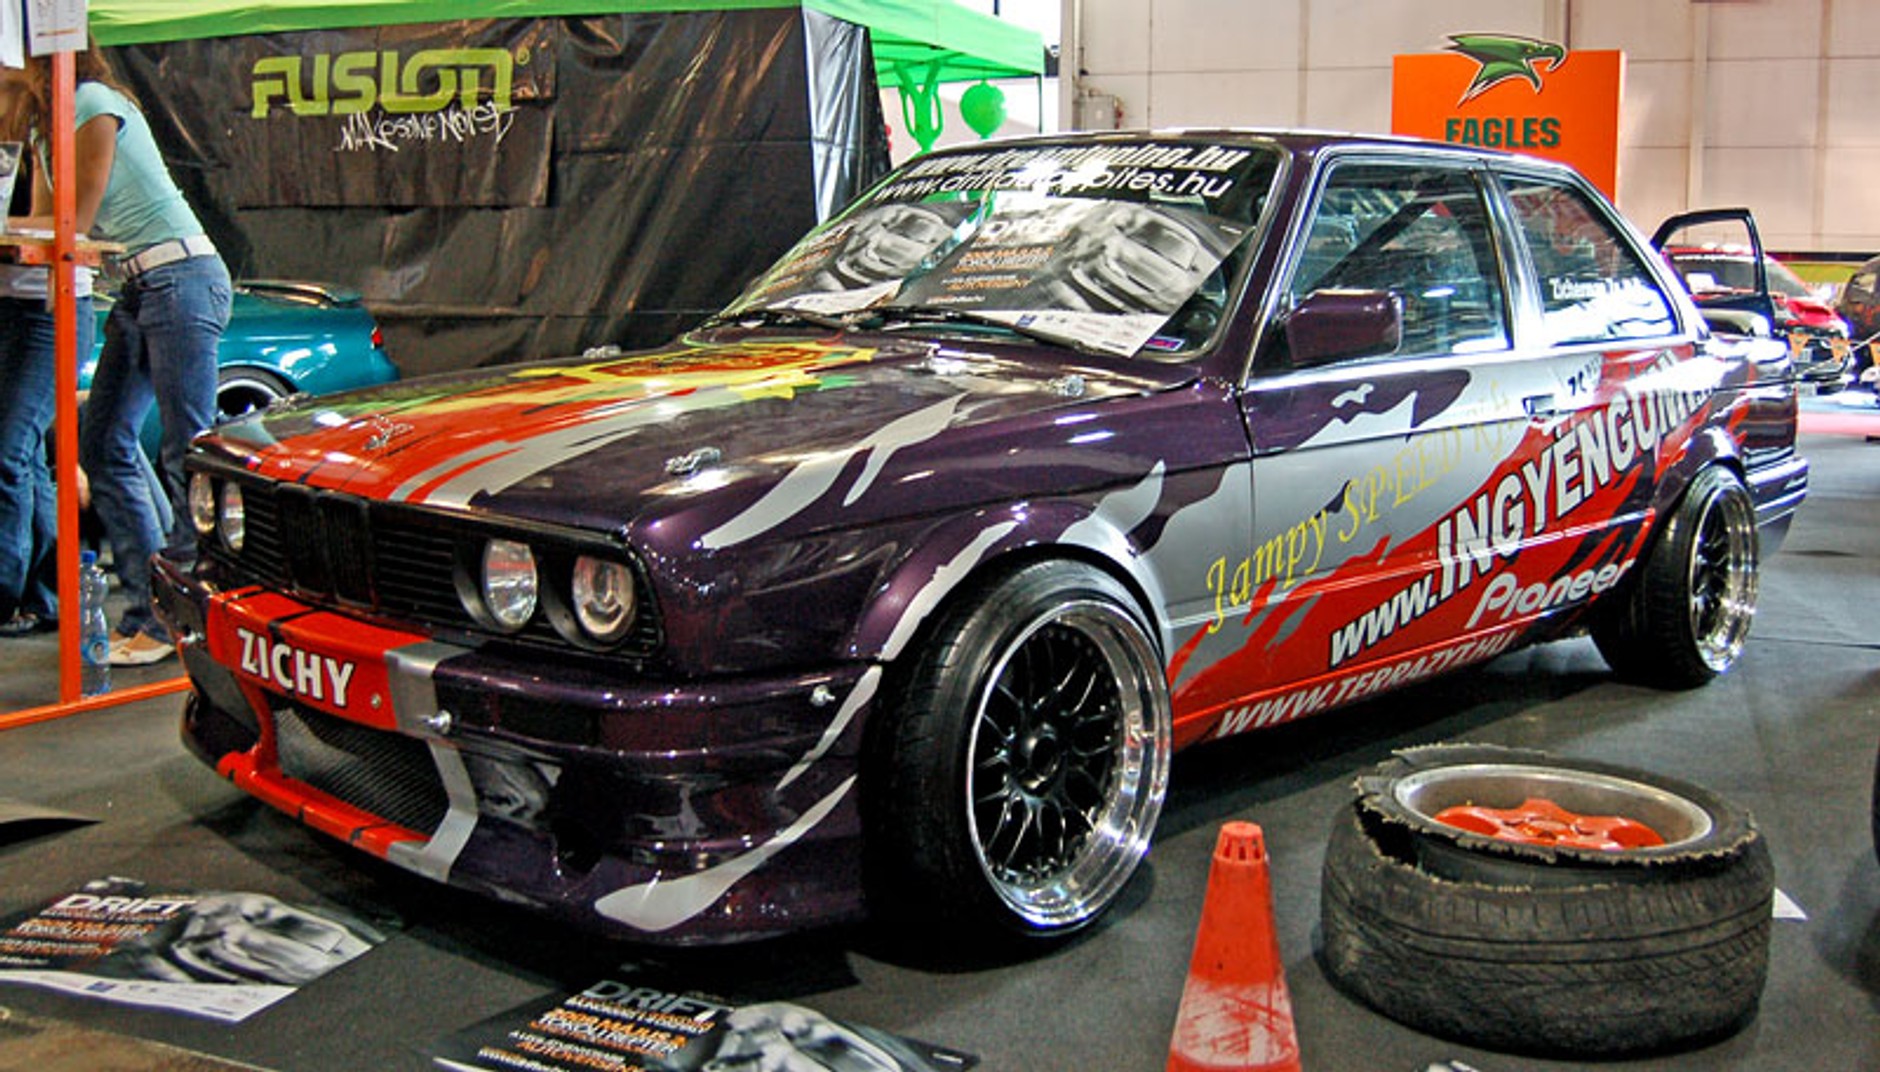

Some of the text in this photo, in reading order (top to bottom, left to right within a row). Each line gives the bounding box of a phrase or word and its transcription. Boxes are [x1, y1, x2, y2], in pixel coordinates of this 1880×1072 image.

[250, 47, 514, 119] FUSION
[1444, 117, 1562, 147] EAGLES
[1464, 558, 1636, 630] Pioneer
[236, 627, 354, 707] ZICHY
[582, 979, 736, 1022] DRIFT
